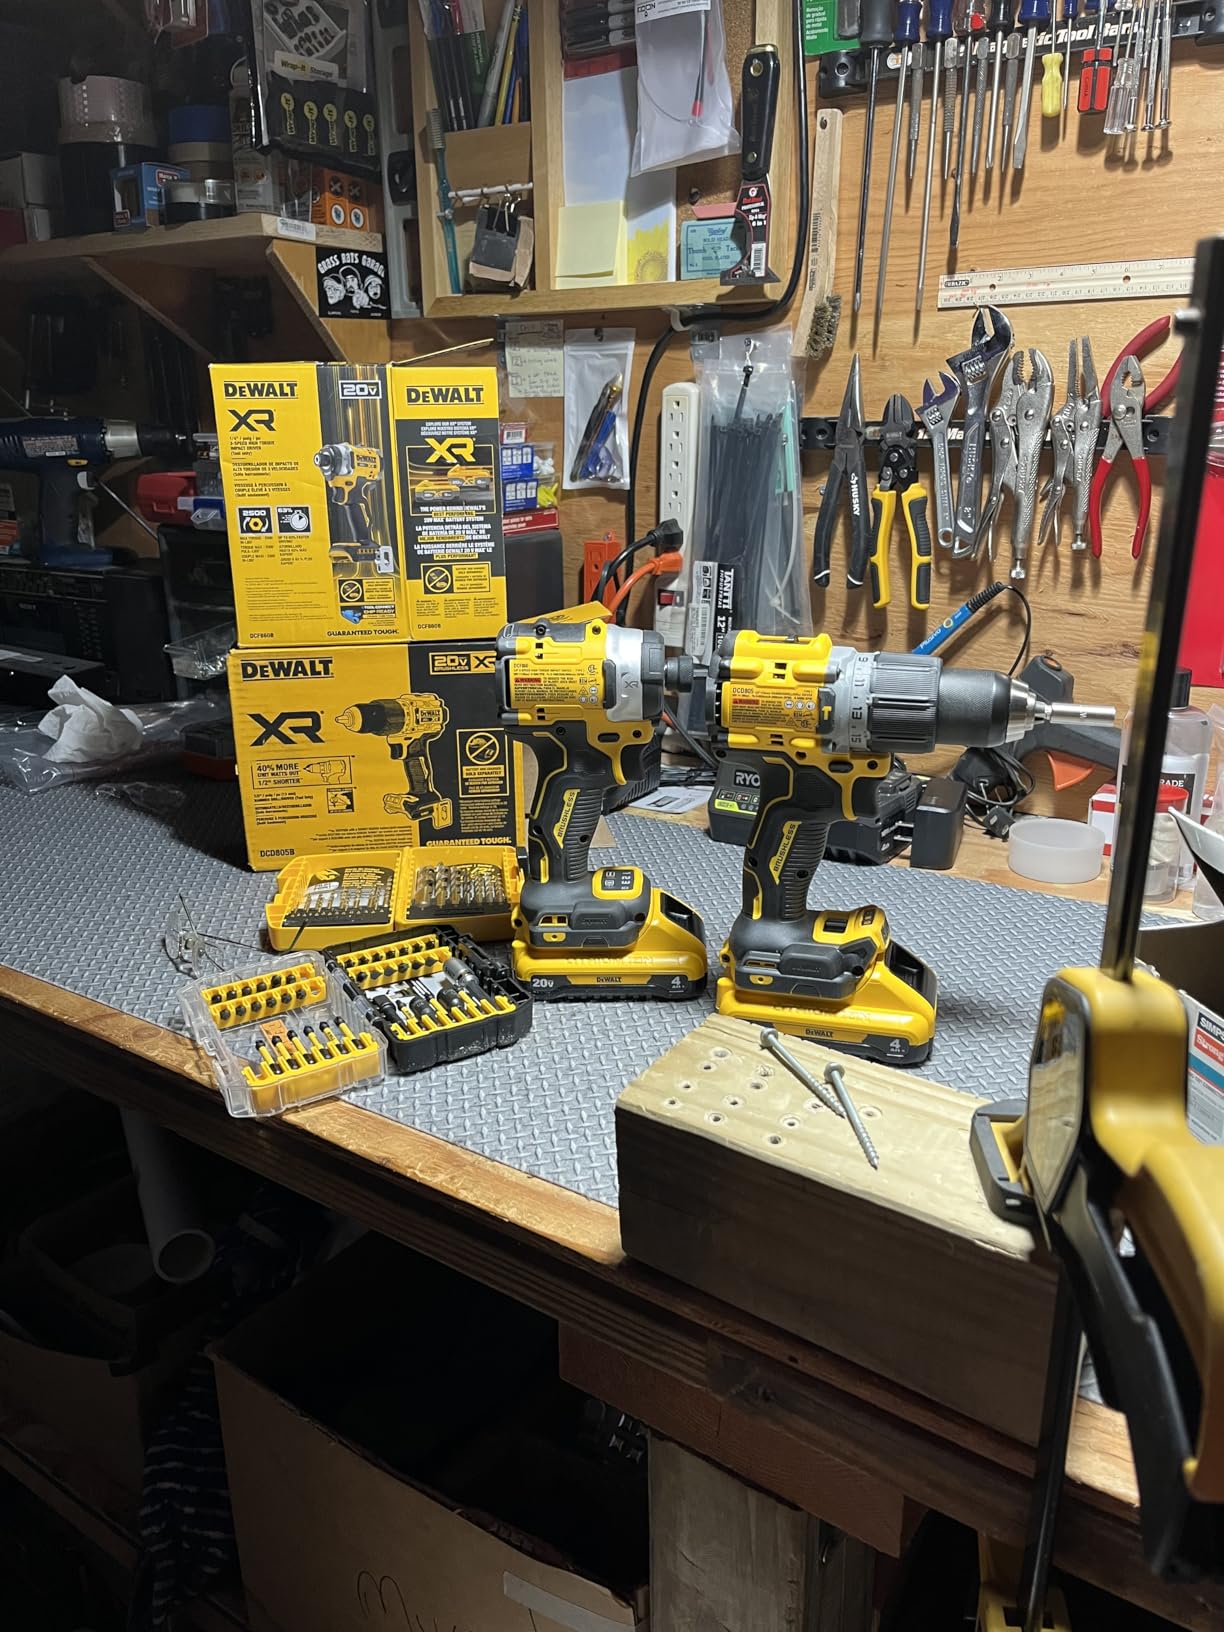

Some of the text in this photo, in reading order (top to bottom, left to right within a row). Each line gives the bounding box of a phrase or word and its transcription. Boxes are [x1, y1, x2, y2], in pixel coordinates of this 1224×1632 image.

[1056, 24, 1097, 45] Tool
[318, 254, 340, 274] GRASS
[340, 252, 359, 264] RATS
[224, 382, 298, 398] DEWALT
[342, 384, 378, 396] 20V
[406, 388, 484, 403] DEWALT
[228, 409, 276, 432] XR
[424, 438, 476, 463] XR
[850, 484, 861, 516] HUSKY
[241, 660, 334, 679] DEWALT
[434, 656, 468, 667] 20V
[248, 710, 325, 746] XR
[256, 764, 275, 772] 40%
[735, 771, 760, 788] RYO
[556, 790, 577, 838] BRUSHLESS
[426, 836, 512, 846] GUARANTEED TOUGH.
[774, 823, 796, 871] BRUSHLESS
[260, 848, 295, 858] DCD805B
[532, 978, 554, 988] 20V
[672, 976, 680, 986] 4
[805, 1028, 901, 1050] DEWALT 4
